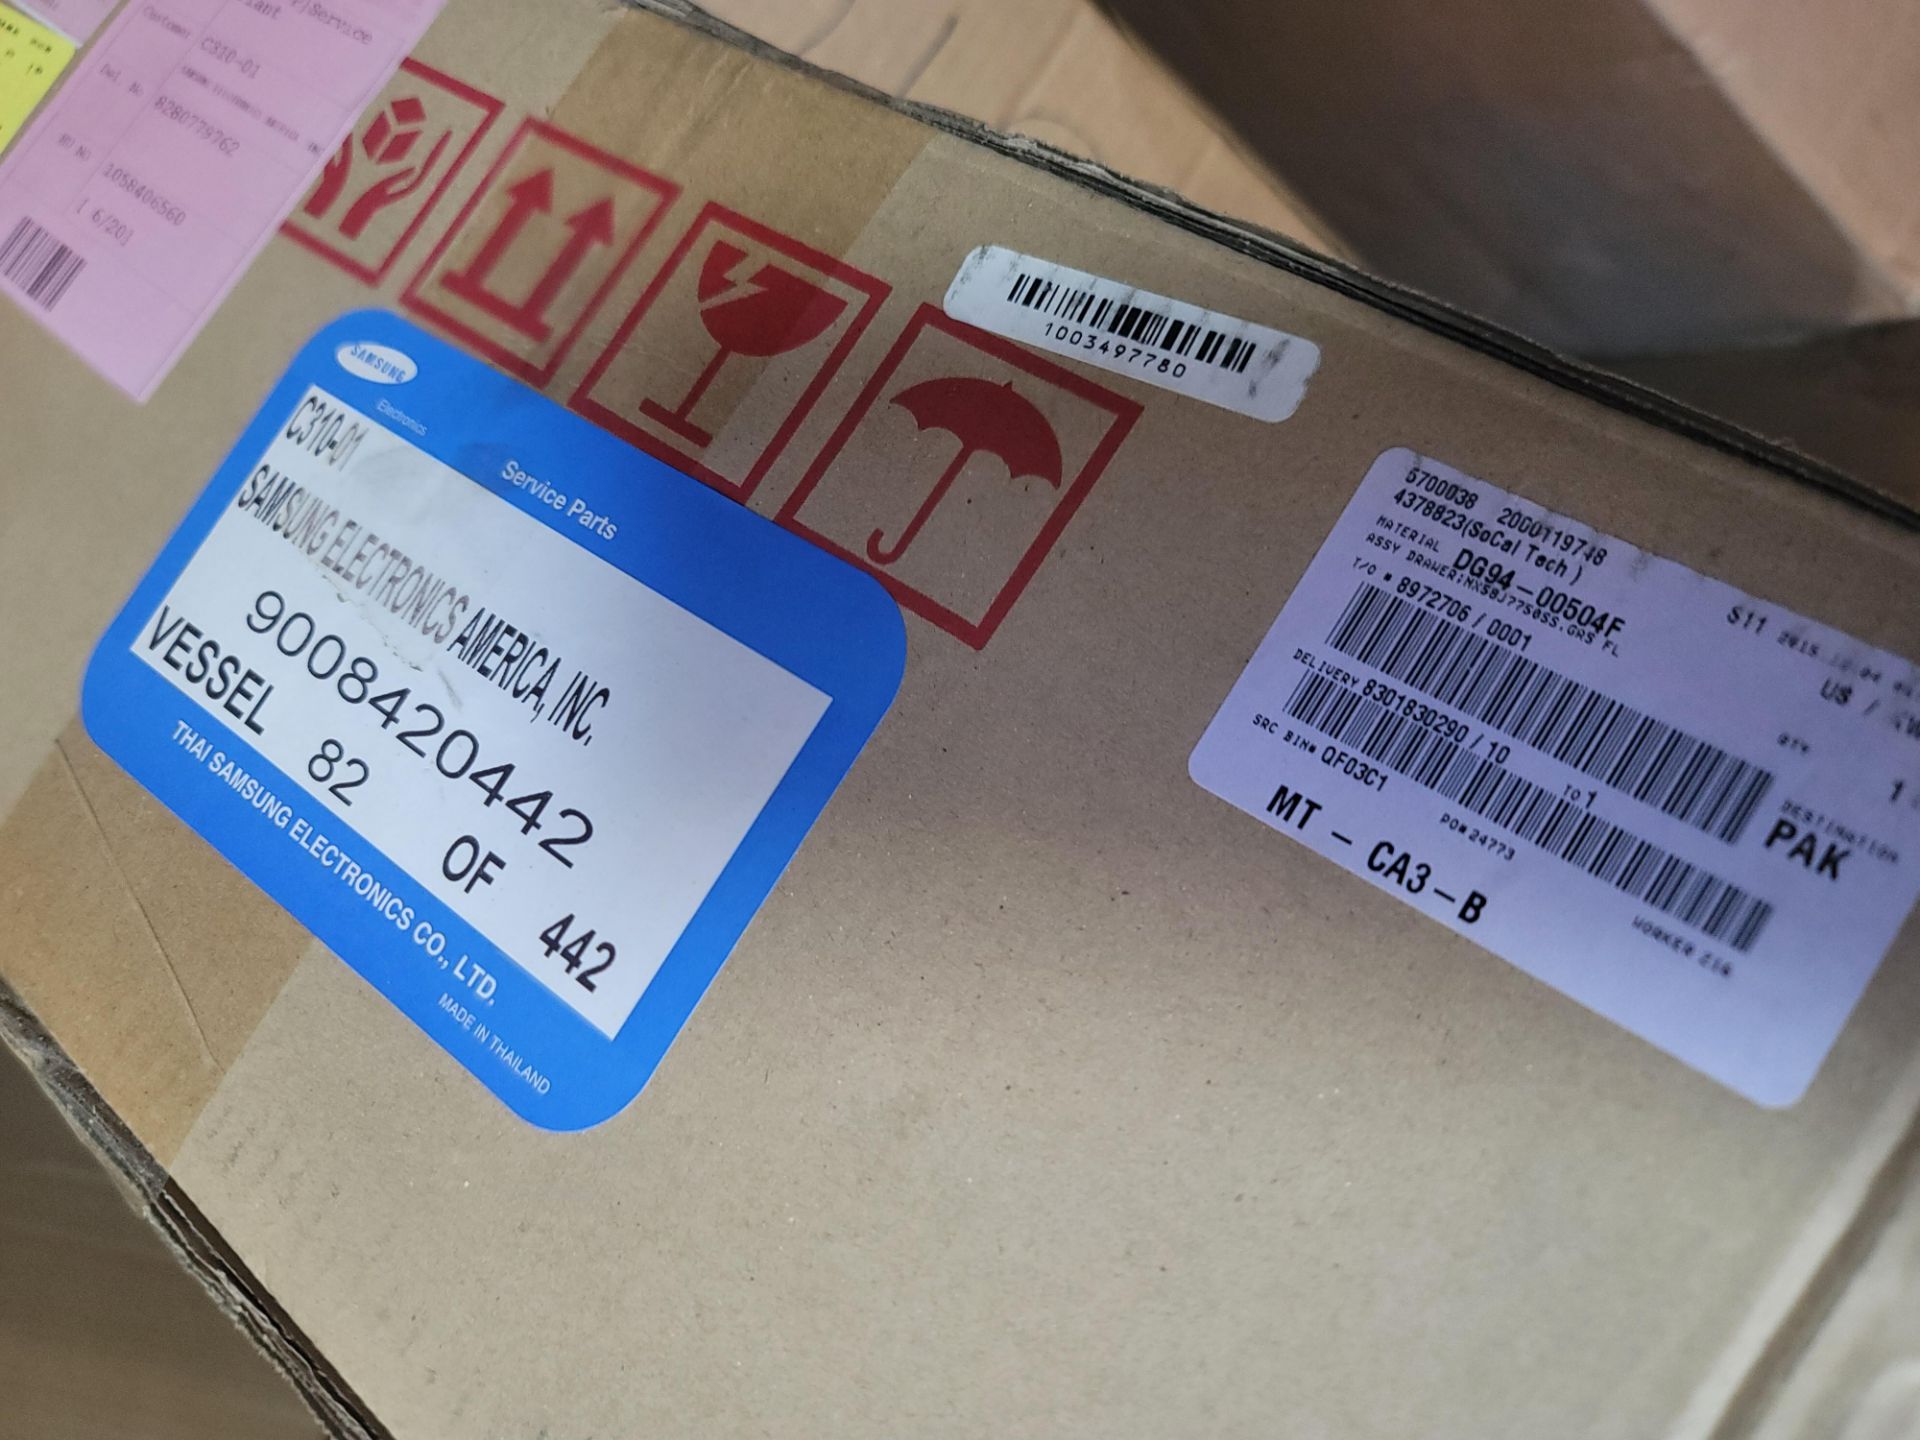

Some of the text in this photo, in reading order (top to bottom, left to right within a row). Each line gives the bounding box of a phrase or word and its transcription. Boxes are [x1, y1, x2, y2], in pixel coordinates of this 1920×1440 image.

[201, 37, 262, 80] C310-01
[104, 163, 186, 226] 1058406560
[350, 344, 406, 383] SAMSUNG
[1044, 322, 1187, 379] 1003497780
[284, 396, 369, 472] C310-01
[377, 398, 428, 436] Electronics
[502, 459, 619, 541] Service Parts
[1404, 467, 1480, 510] 5700038
[1376, 514, 1440, 553] MATERIAL
[1524, 543, 1569, 577] Tech
[238, 463, 340, 556] SAMSUNG
[321, 519, 470, 645] ELECTRONICS
[446, 607, 562, 724] AMERICA,
[1365, 532, 1402, 555] ASSY
[1602, 641, 1620, 658] FL
[1396, 575, 1473, 622] 8972706
[1486, 618, 1532, 652] 0001
[245, 590, 595, 869] 9008420442
[1293, 648, 1360, 688] DELIVERY
[1362, 678, 1471, 744] 8301830290
[1486, 740, 1512, 765] 10
[1252, 713, 1279, 735] SRC
[1320, 746, 1389, 792] QF03C1
[148, 605, 617, 994] VESSEL 82 OF 442
[1266, 785, 1323, 830] MT
[1563, 784, 1582, 802] TO
[170, 719, 214, 762] THAI
[208, 751, 294, 830] SAMSUNG
[289, 818, 416, 932] ELECTRONICS
[412, 921, 450, 970] CO.,
[1764, 817, 1851, 881] PAK
[438, 992, 551, 1094] MADE IN THAILAND
